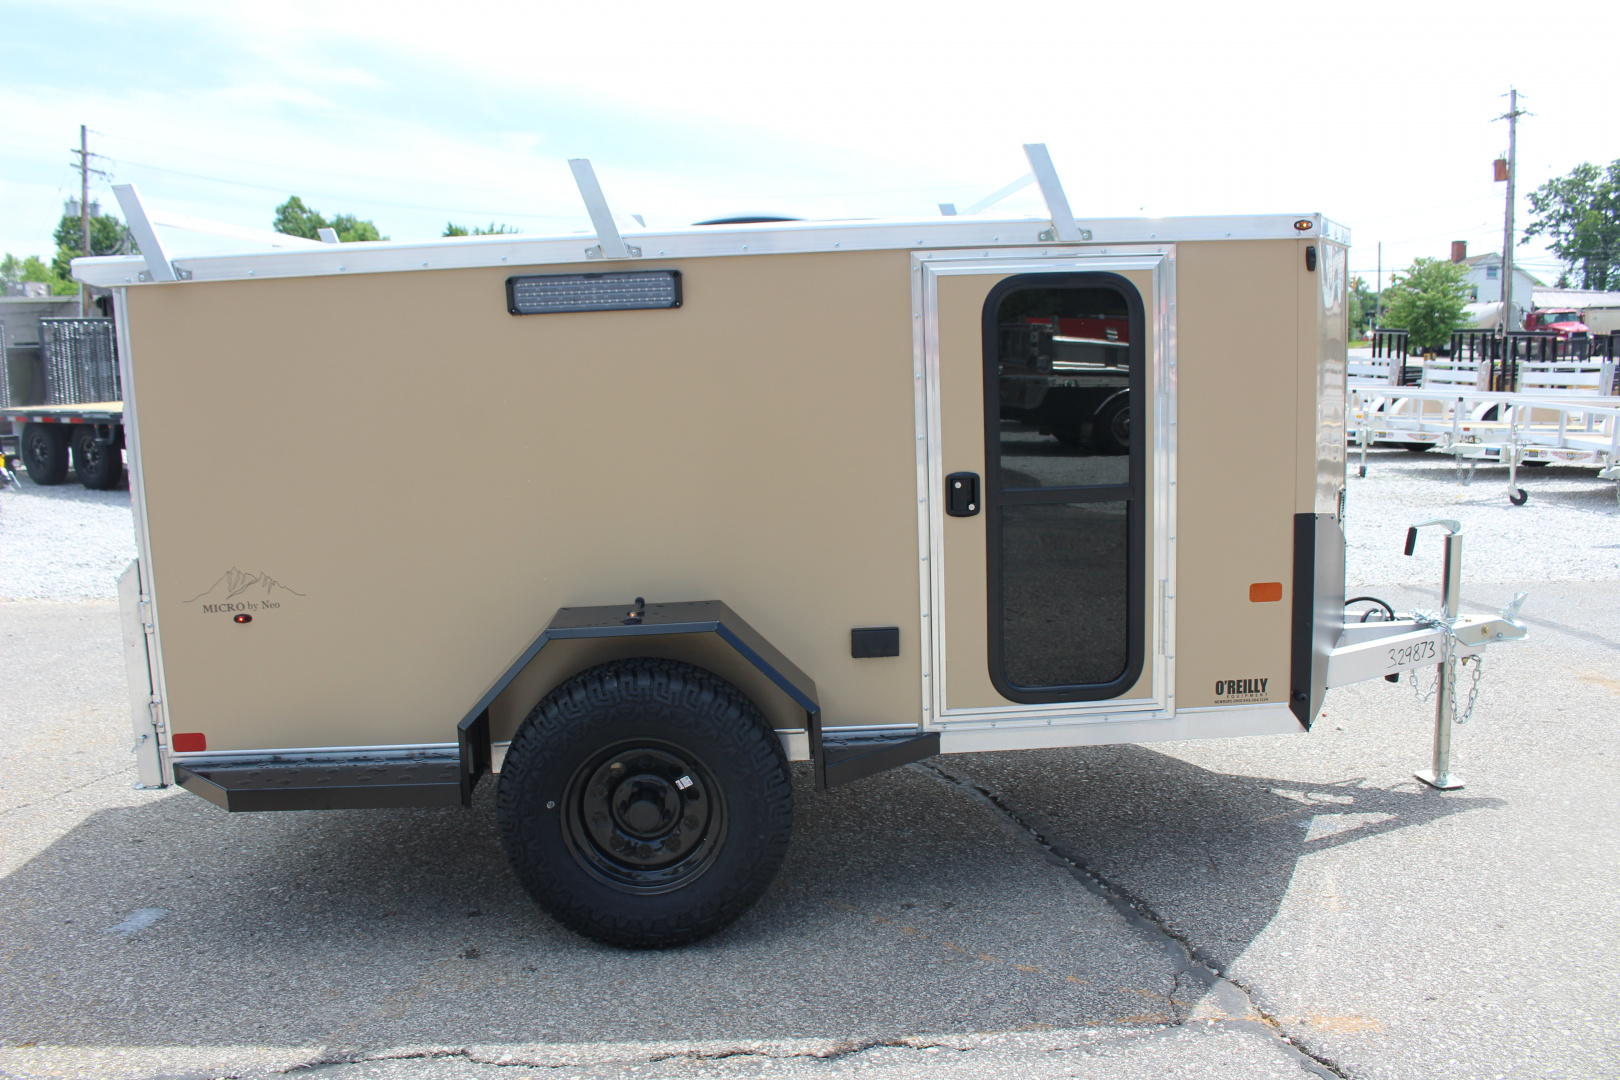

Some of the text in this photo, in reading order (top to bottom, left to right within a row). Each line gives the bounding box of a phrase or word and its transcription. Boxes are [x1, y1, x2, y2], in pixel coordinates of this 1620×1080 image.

[202, 600, 280, 613] MICRO by Neo
[1387, 641, 1435, 668] 329873
[1215, 678, 1268, 695] O'REILLY
